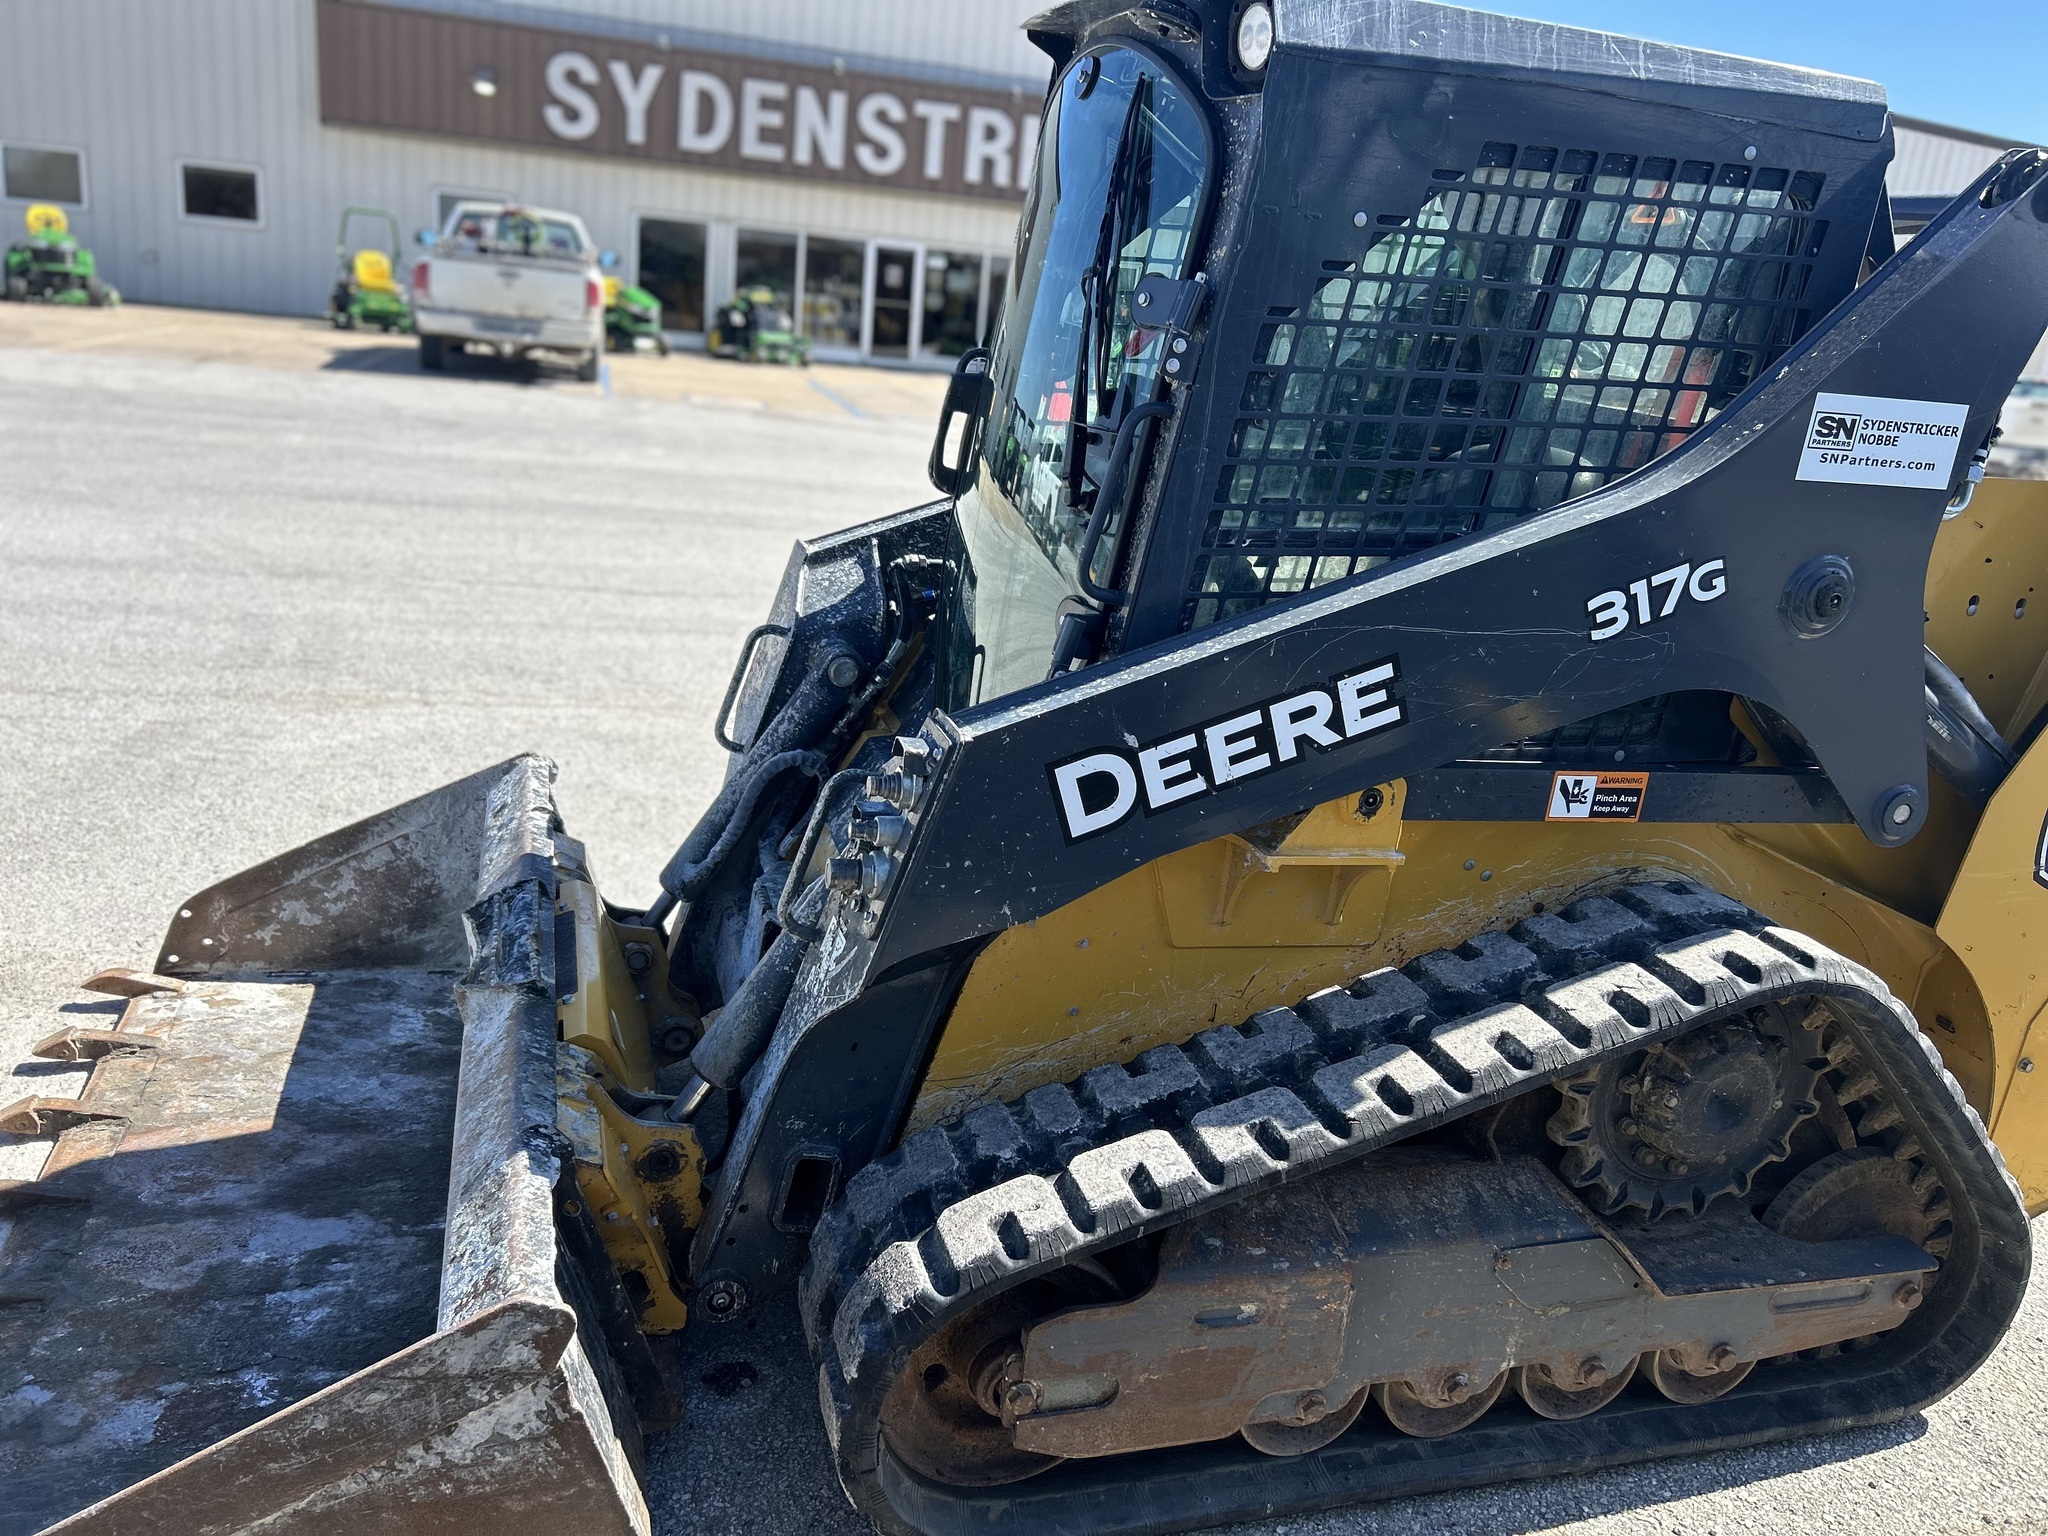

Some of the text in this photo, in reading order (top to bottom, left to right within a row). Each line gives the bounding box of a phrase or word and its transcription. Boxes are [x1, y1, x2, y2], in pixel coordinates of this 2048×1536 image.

[1862, 419, 1958, 437] SYDENSTRICKER
[1811, 438, 1852, 448] PARTNERS
[1857, 432, 1900, 447] NOBBE
[1819, 453, 1936, 471] SNPartners.com
[1587, 559, 1727, 642] 317G
[1053, 662, 1403, 840] DEERE
[1608, 777, 1643, 785] WARNING
[1595, 794, 1638, 803] Pinch Area
[1592, 804, 1630, 814] Keep Away
